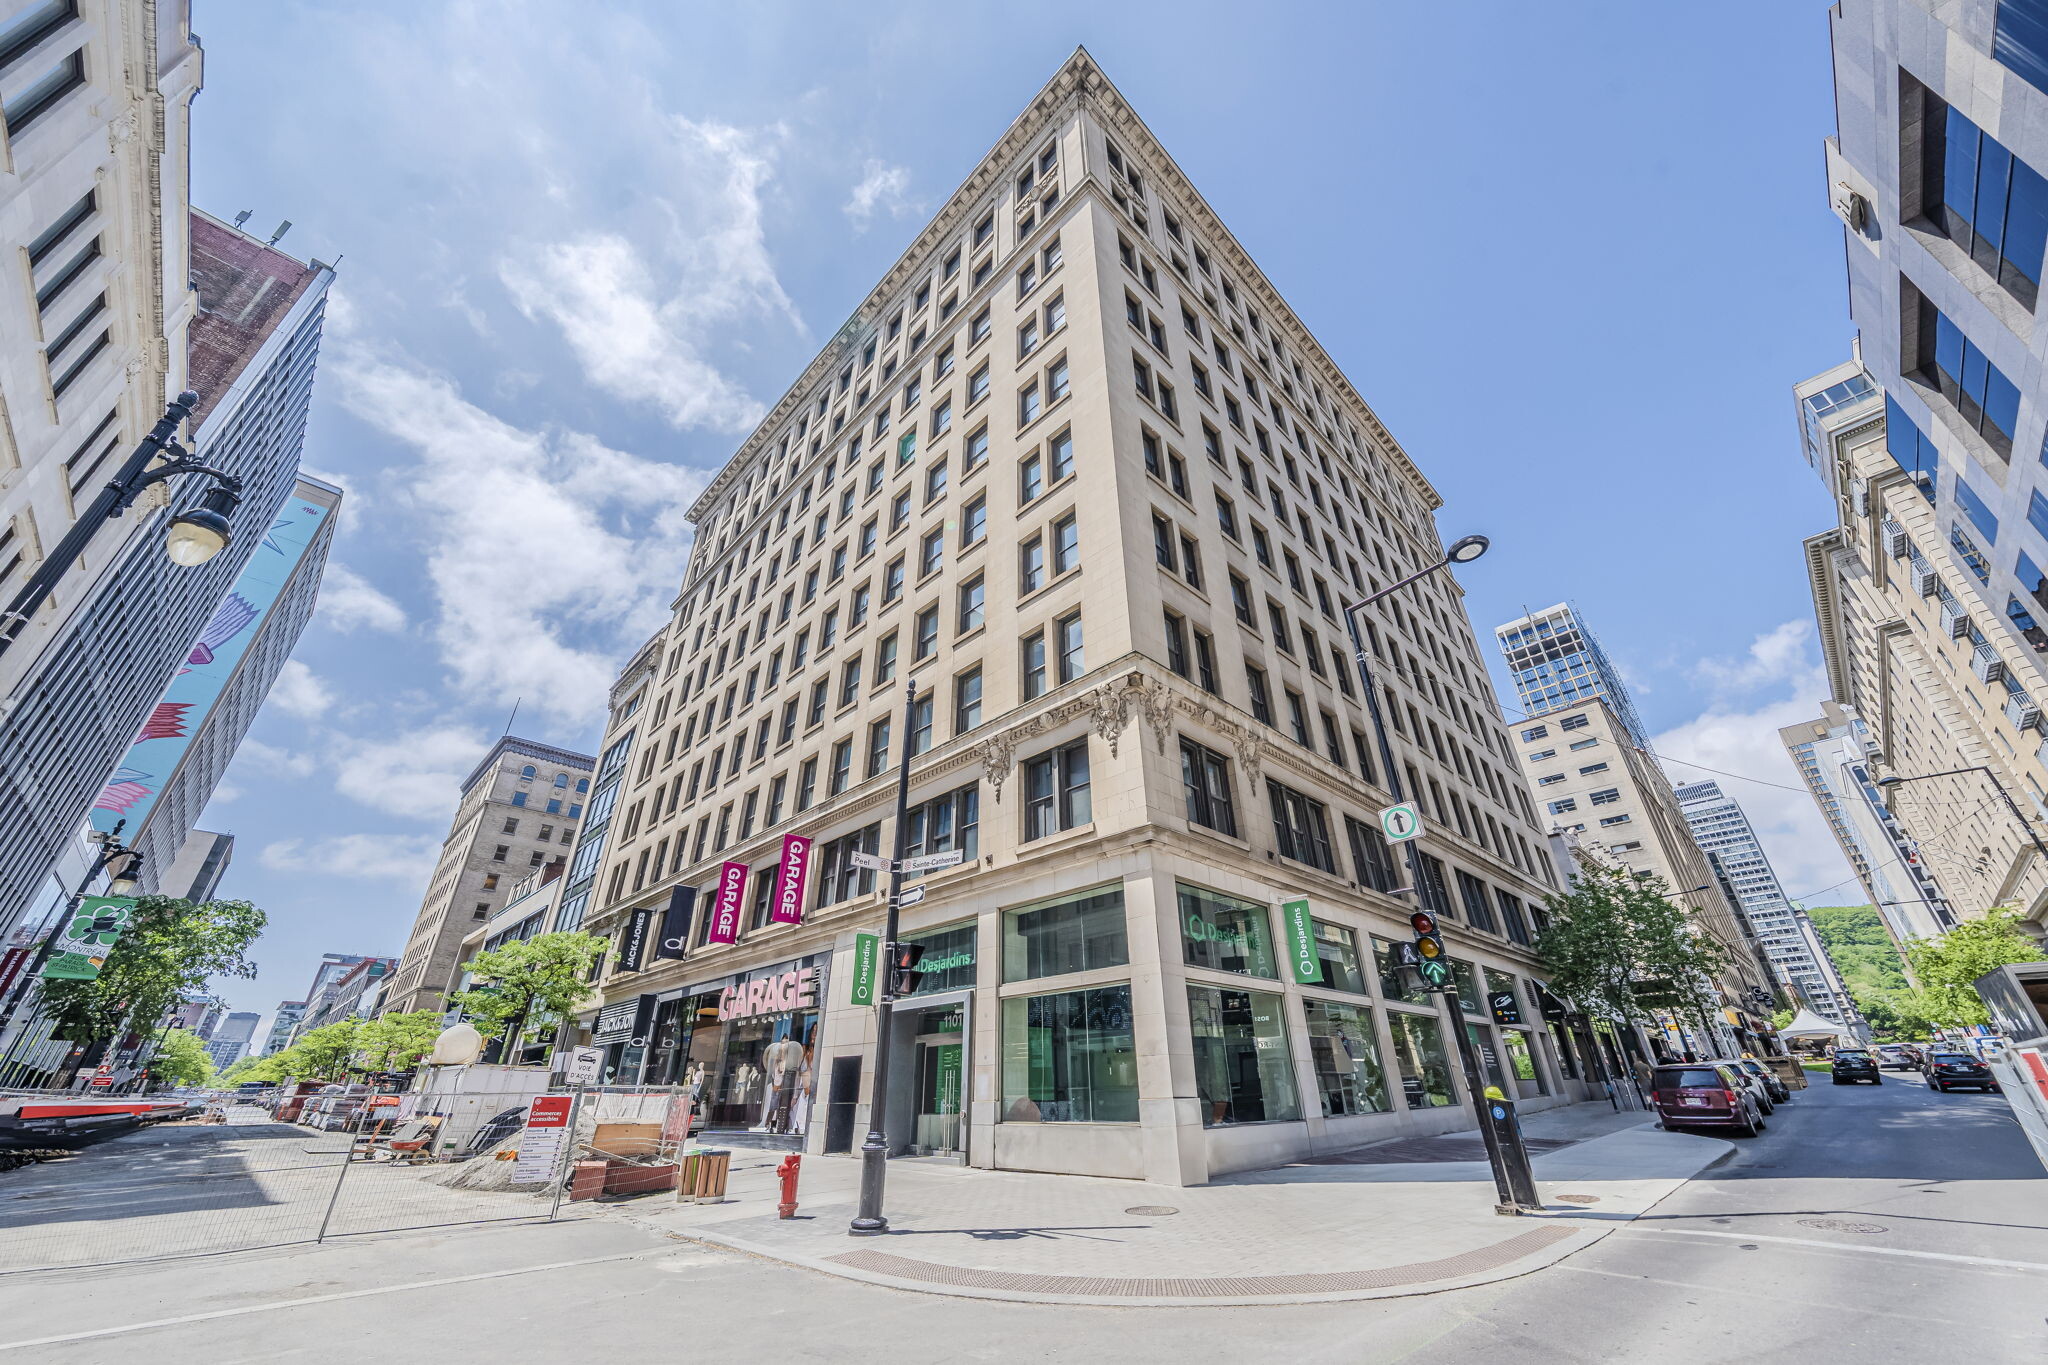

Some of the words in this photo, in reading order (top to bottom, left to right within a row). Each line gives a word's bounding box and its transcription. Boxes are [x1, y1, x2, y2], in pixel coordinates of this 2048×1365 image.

[854, 857, 871, 866] Peel
[912, 856, 960, 868] Sainte-Catherine
[781, 840, 804, 916] GARAGE
[717, 867, 742, 938] GARAGE
[626, 912, 646, 968] JACK&JONES
[1294, 907, 1309, 958] Desjardins
[59, 943, 106, 956] MONTRÉAL
[859, 940, 871, 984] Desjardins
[921, 952, 971, 973] Desjardins
[719, 967, 814, 1021] GARAGE
[944, 1013, 963, 1027] 1101
[570, 1072, 594, 1081] D'ACCÈS
